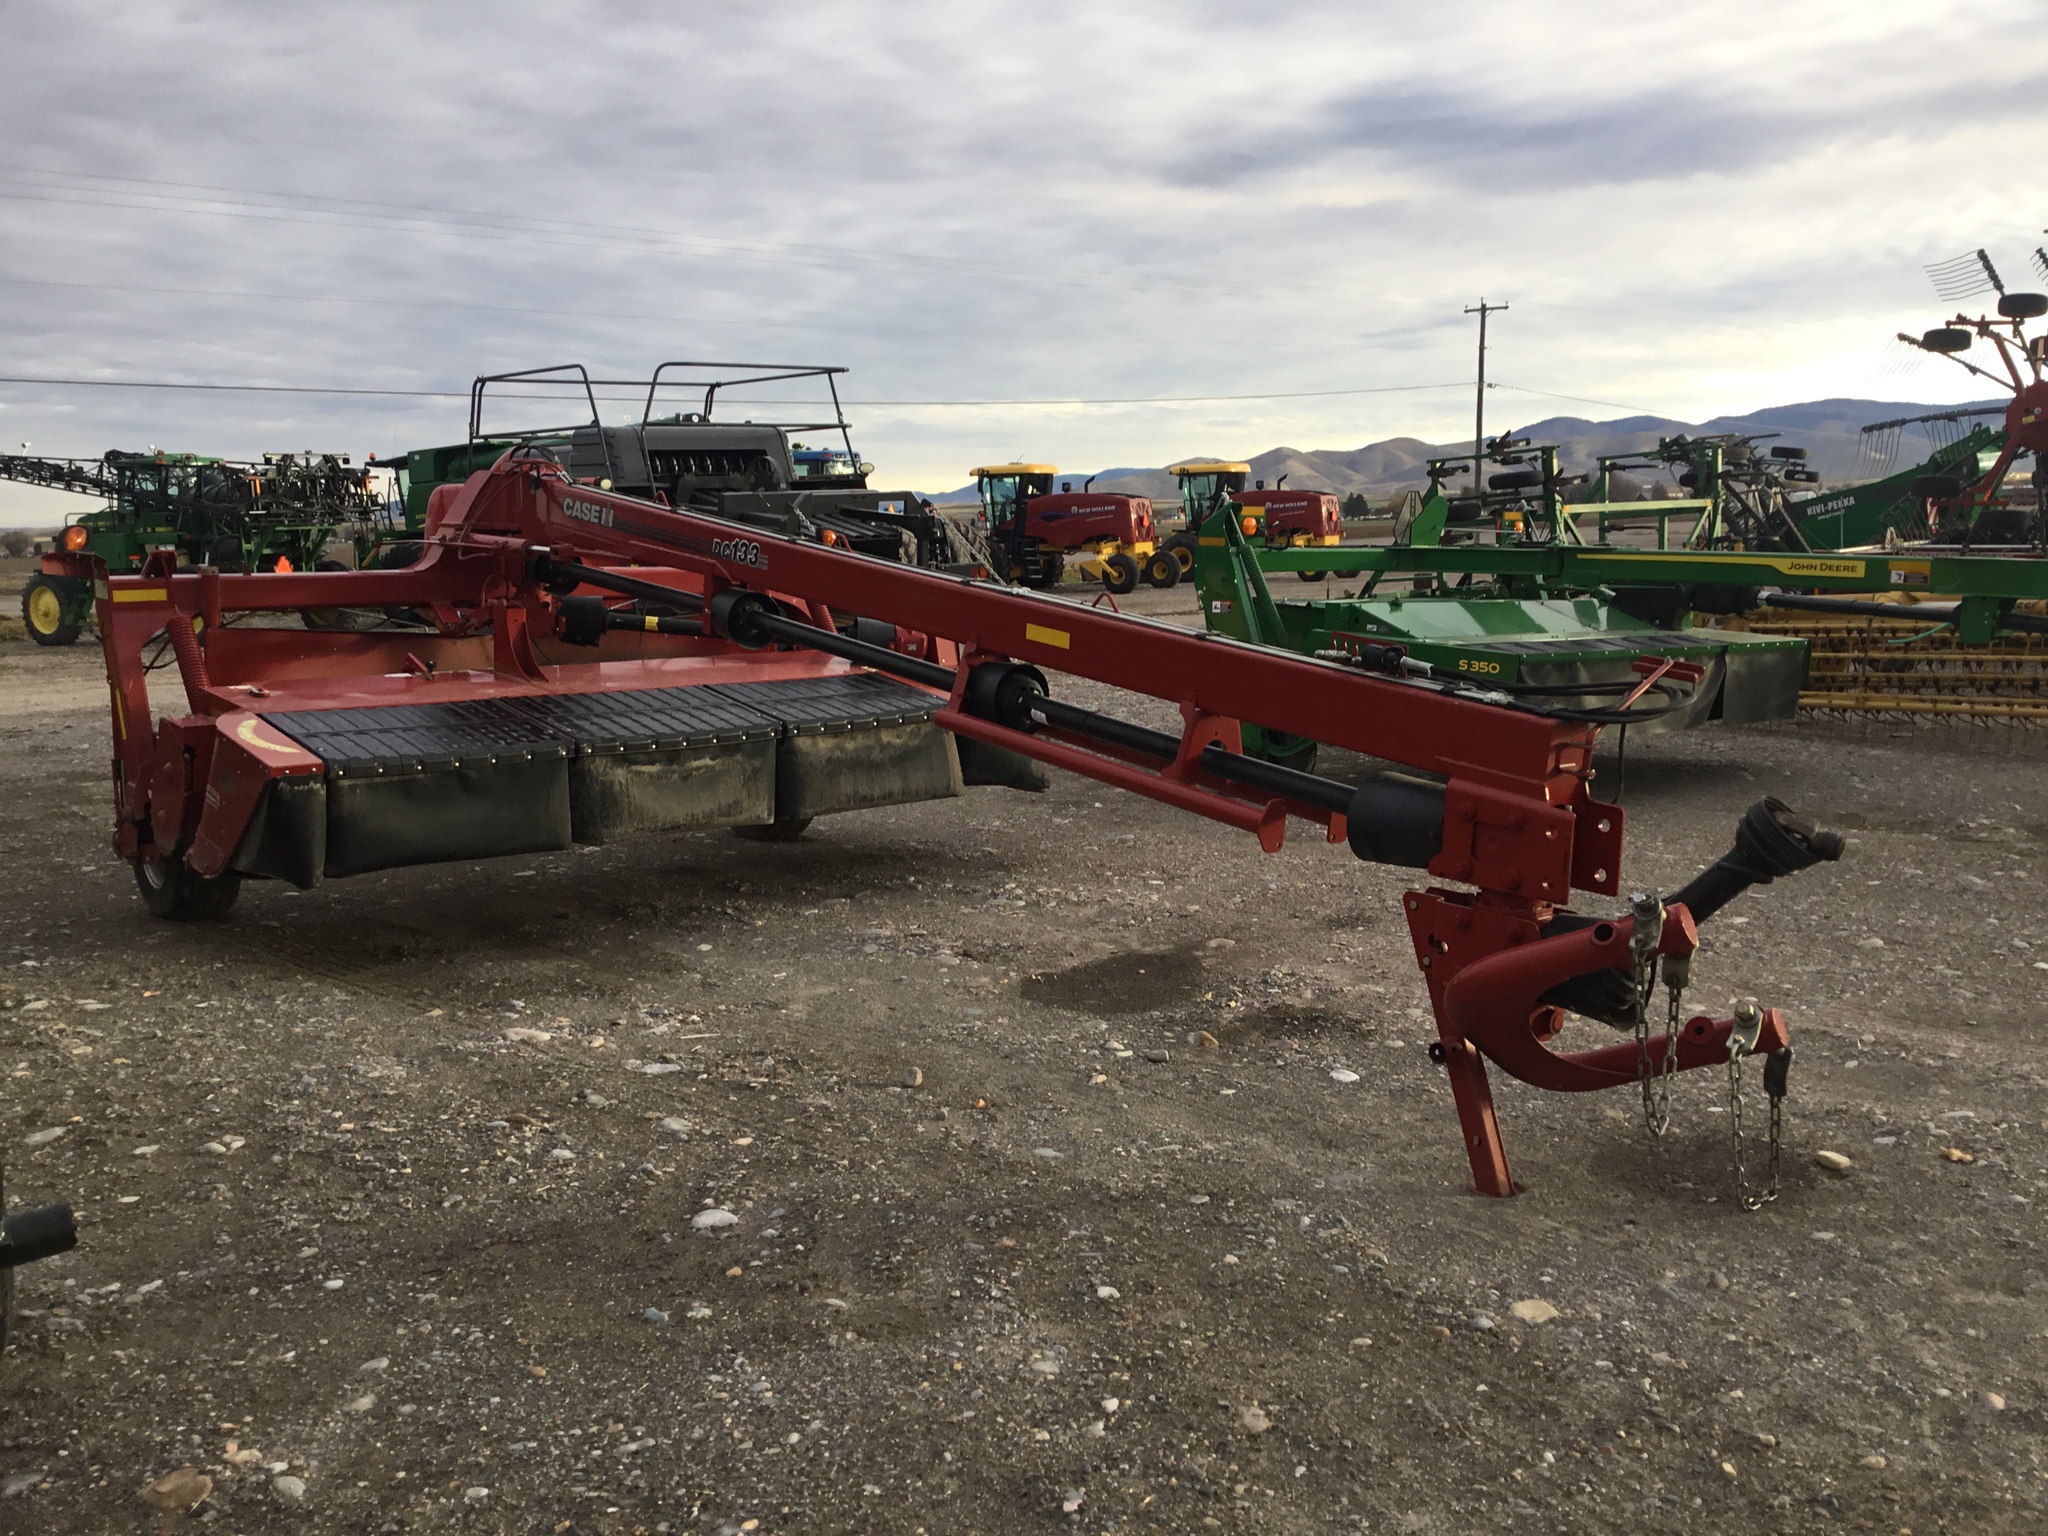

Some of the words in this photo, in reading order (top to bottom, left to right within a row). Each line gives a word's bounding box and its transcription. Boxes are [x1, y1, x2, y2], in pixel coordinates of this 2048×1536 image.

[563, 497, 600, 524] CASE
[1806, 496, 1856, 516] KIVI-PEKKA
[712, 538, 760, 567] DC133
[1787, 562, 1818, 571] JOHN
[1820, 563, 1858, 573] DEERE
[1458, 659, 1469, 671] S
[1470, 660, 1501, 674] 350
